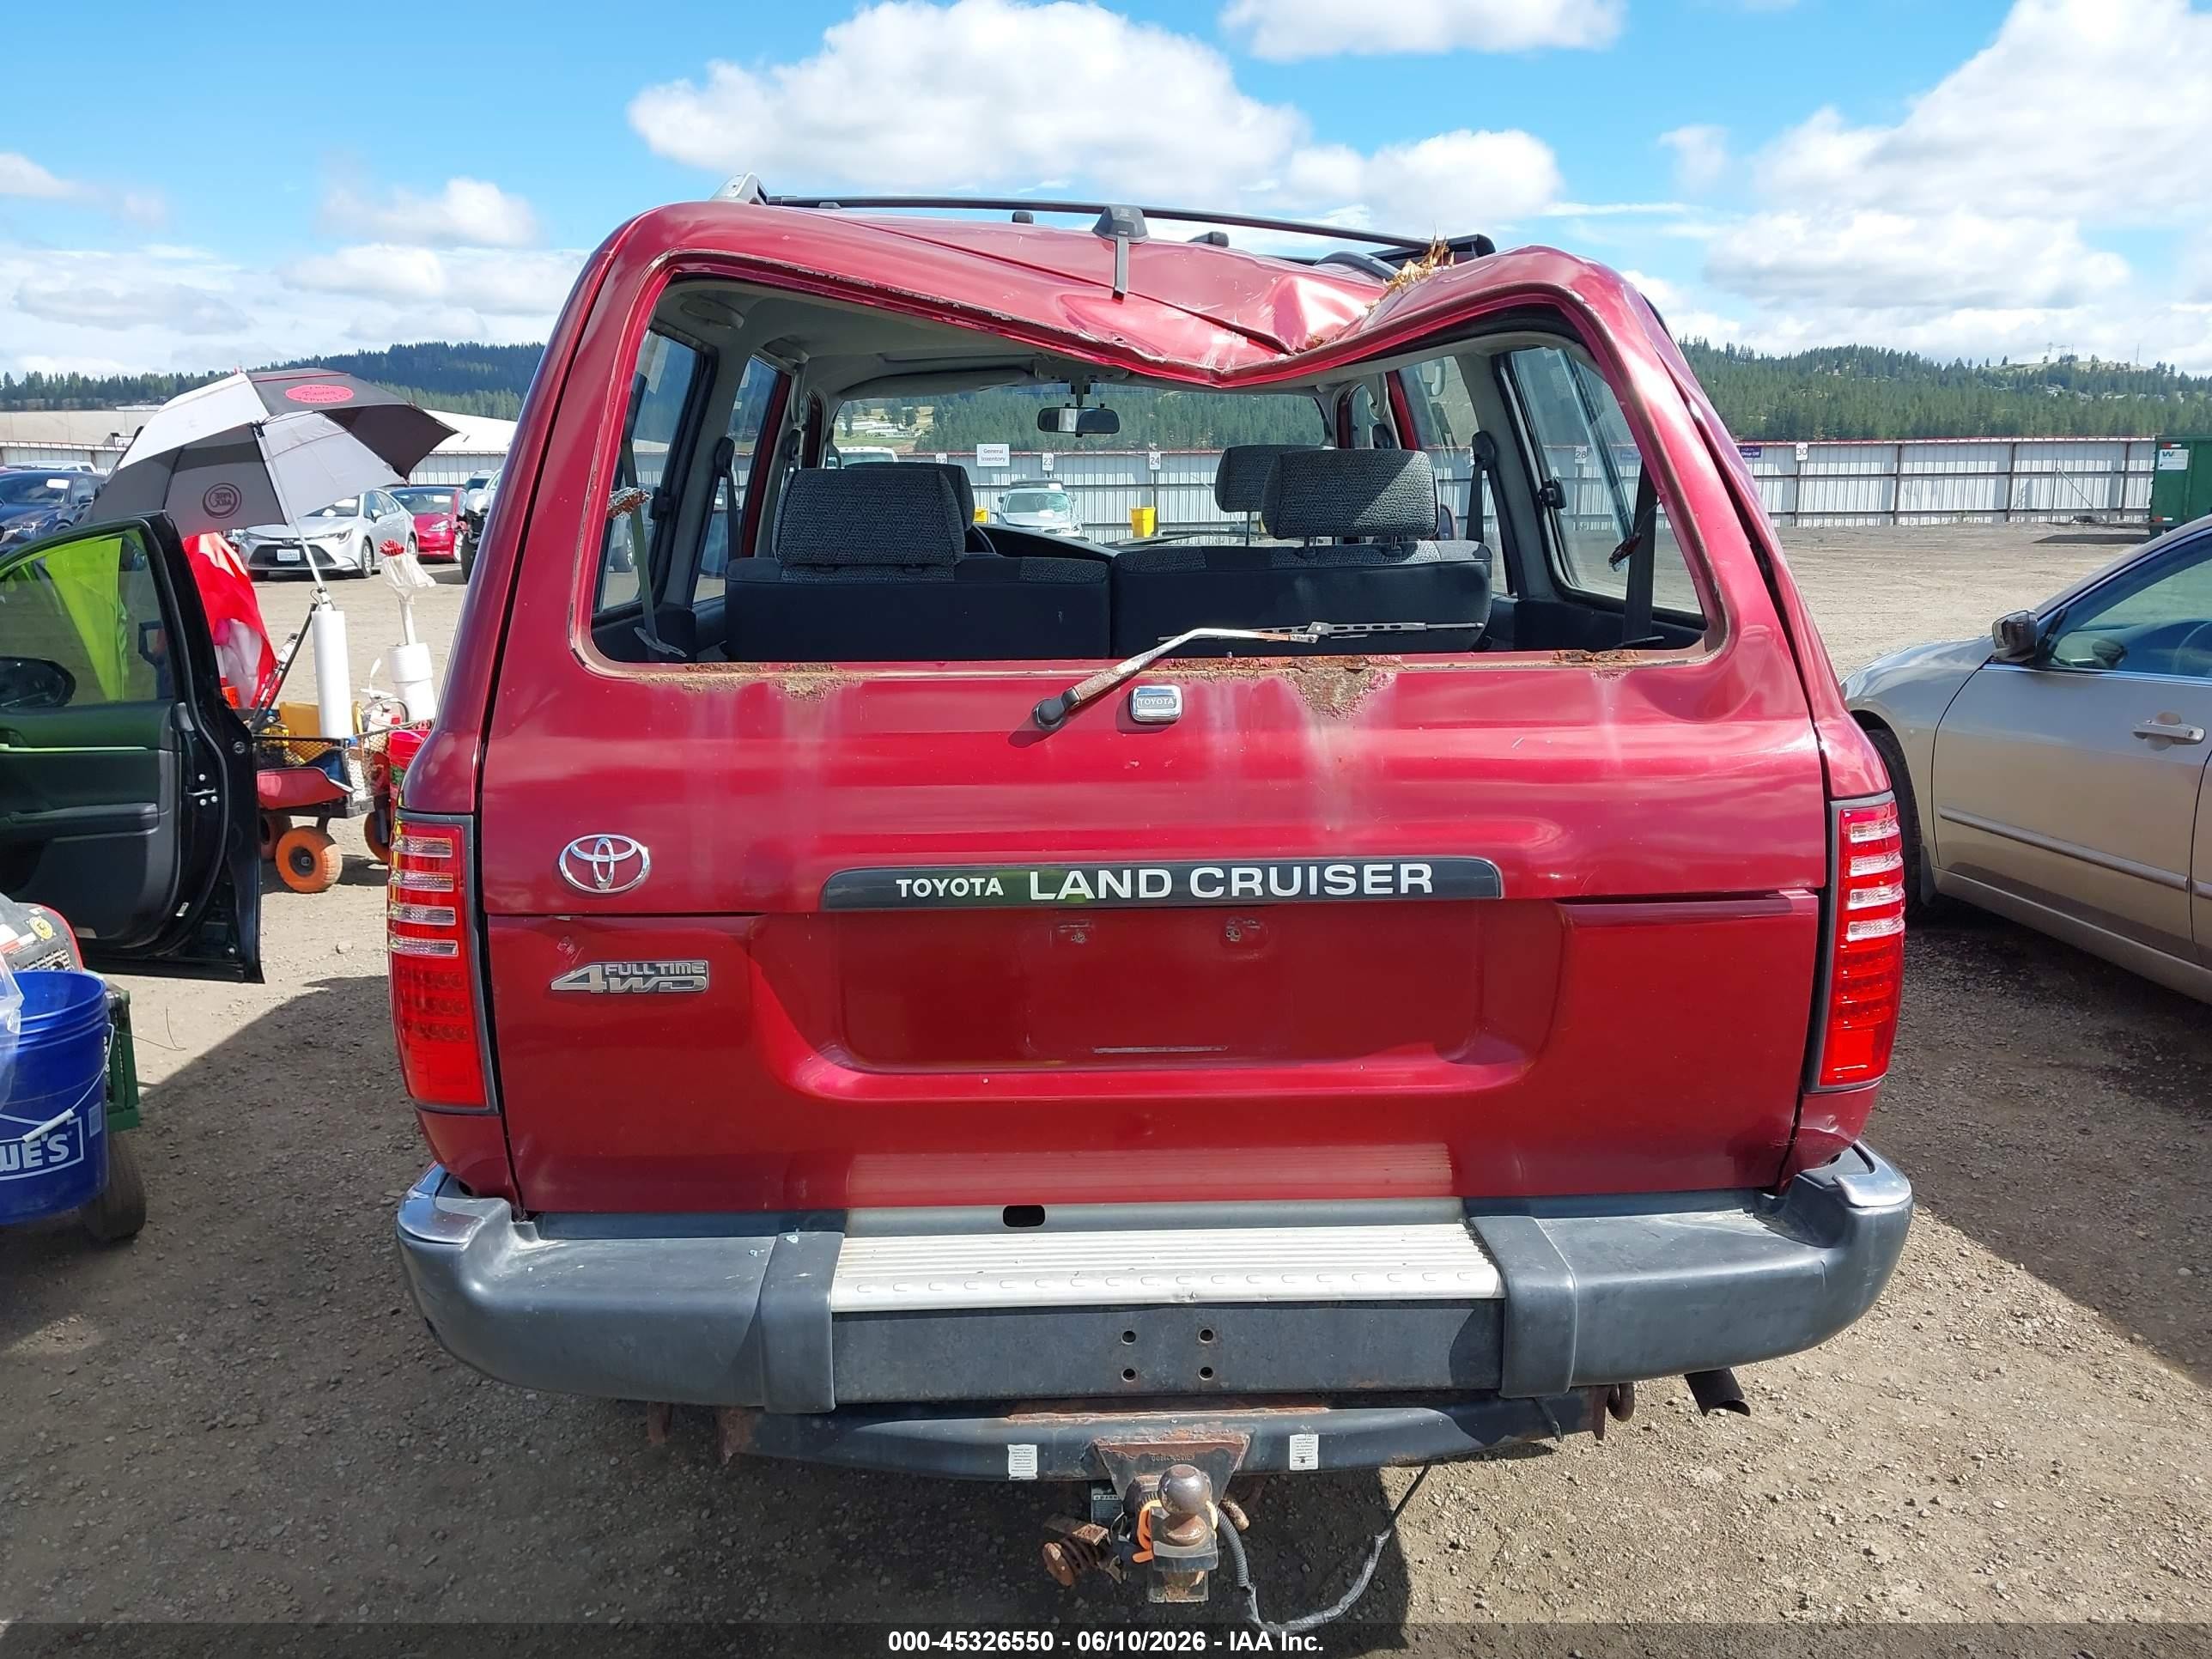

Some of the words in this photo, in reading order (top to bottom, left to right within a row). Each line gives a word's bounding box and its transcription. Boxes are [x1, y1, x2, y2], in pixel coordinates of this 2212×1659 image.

[1796, 447, 1808, 456] 30
[1043, 458, 1053, 466] 23
[1151, 457, 1160, 465] 24
[896, 877, 1004, 897] TOYOTA
[1030, 868, 1173, 901] LAND
[1189, 863, 1433, 898] CRUISER
[605, 963, 656, 975] FULL
[655, 962, 706, 975] TIME
[550, 964, 707, 994] 4WD
